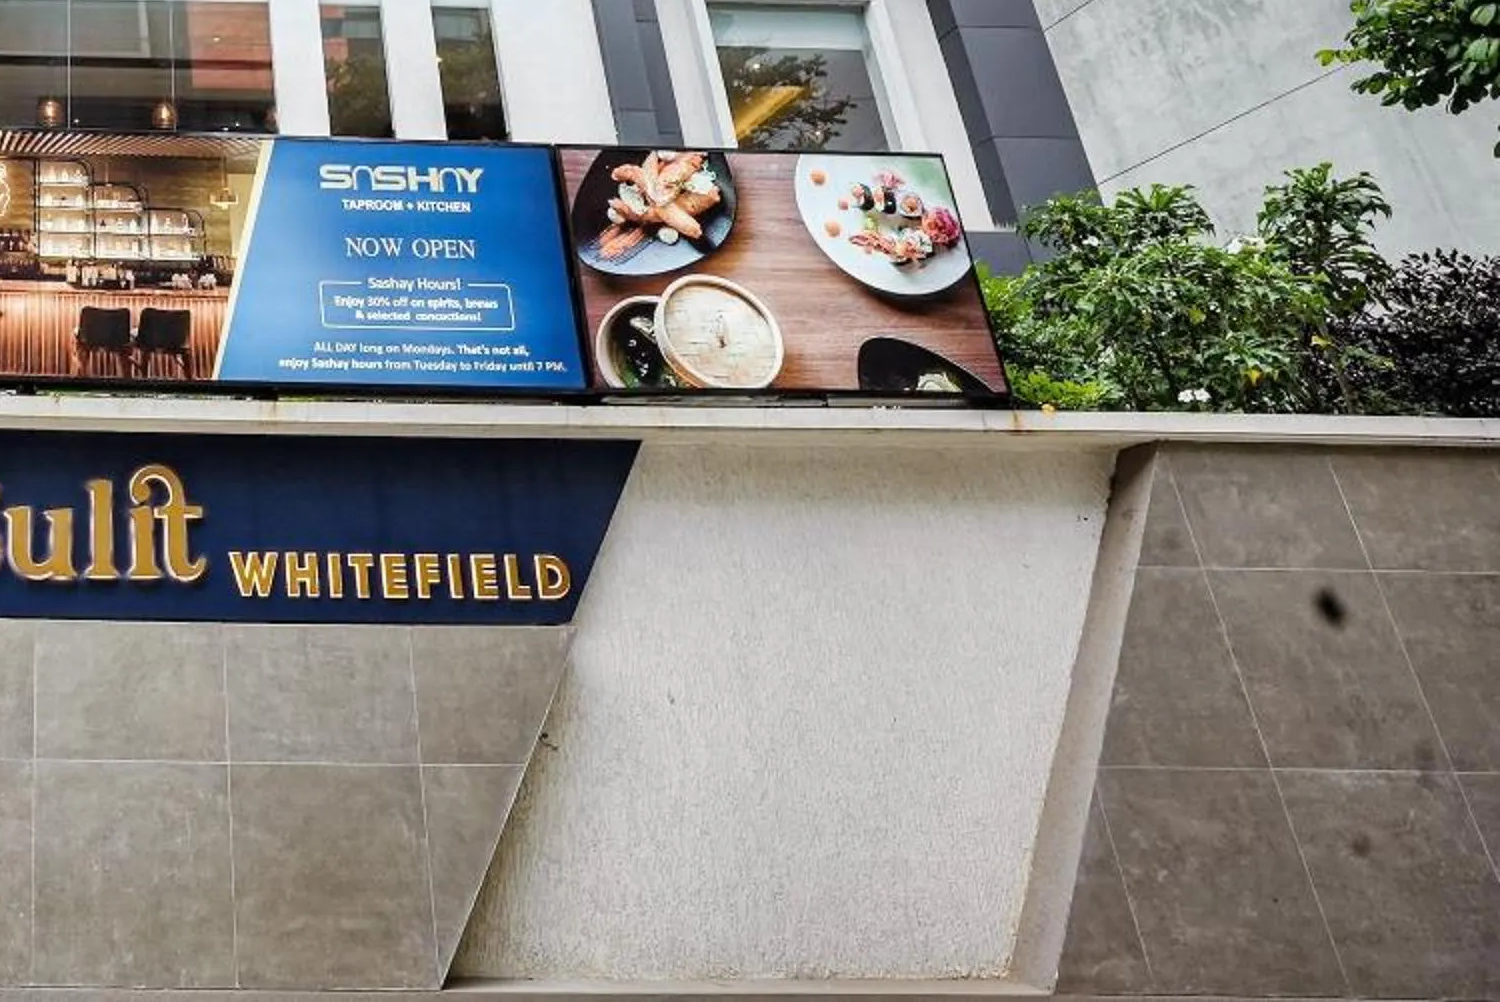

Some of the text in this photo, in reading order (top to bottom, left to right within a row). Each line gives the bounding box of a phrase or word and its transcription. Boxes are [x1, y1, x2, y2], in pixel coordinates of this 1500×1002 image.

[342, 199, 403, 211] TAPROOM
[417, 201, 471, 213] KITCHEN
[345, 237, 476, 260] NOW OPEN
[368, 278, 462, 292] Sashay Hours!
[334, 295, 365, 308] Enjoy
[392, 297, 409, 307] off
[410, 299, 425, 308] on
[427, 298, 463, 311] spirits,
[464, 298, 499, 309] brews
[367, 310, 411, 321] selected
[314, 341, 530, 357] ALL DAY long on Mondays. That's not all,
[278, 358, 309, 370] enjoy
[311, 358, 350, 371] Sashay
[351, 359, 383, 369] hours
[384, 360, 411, 370] from
[413, 360, 458, 372] Tuesday
[459, 362, 473, 371] to
[474, 361, 507, 373] Friday
[509, 362, 535, 371] until
[536, 362, 543, 371] 7
[229, 551, 573, 601] WHITEFIELD
